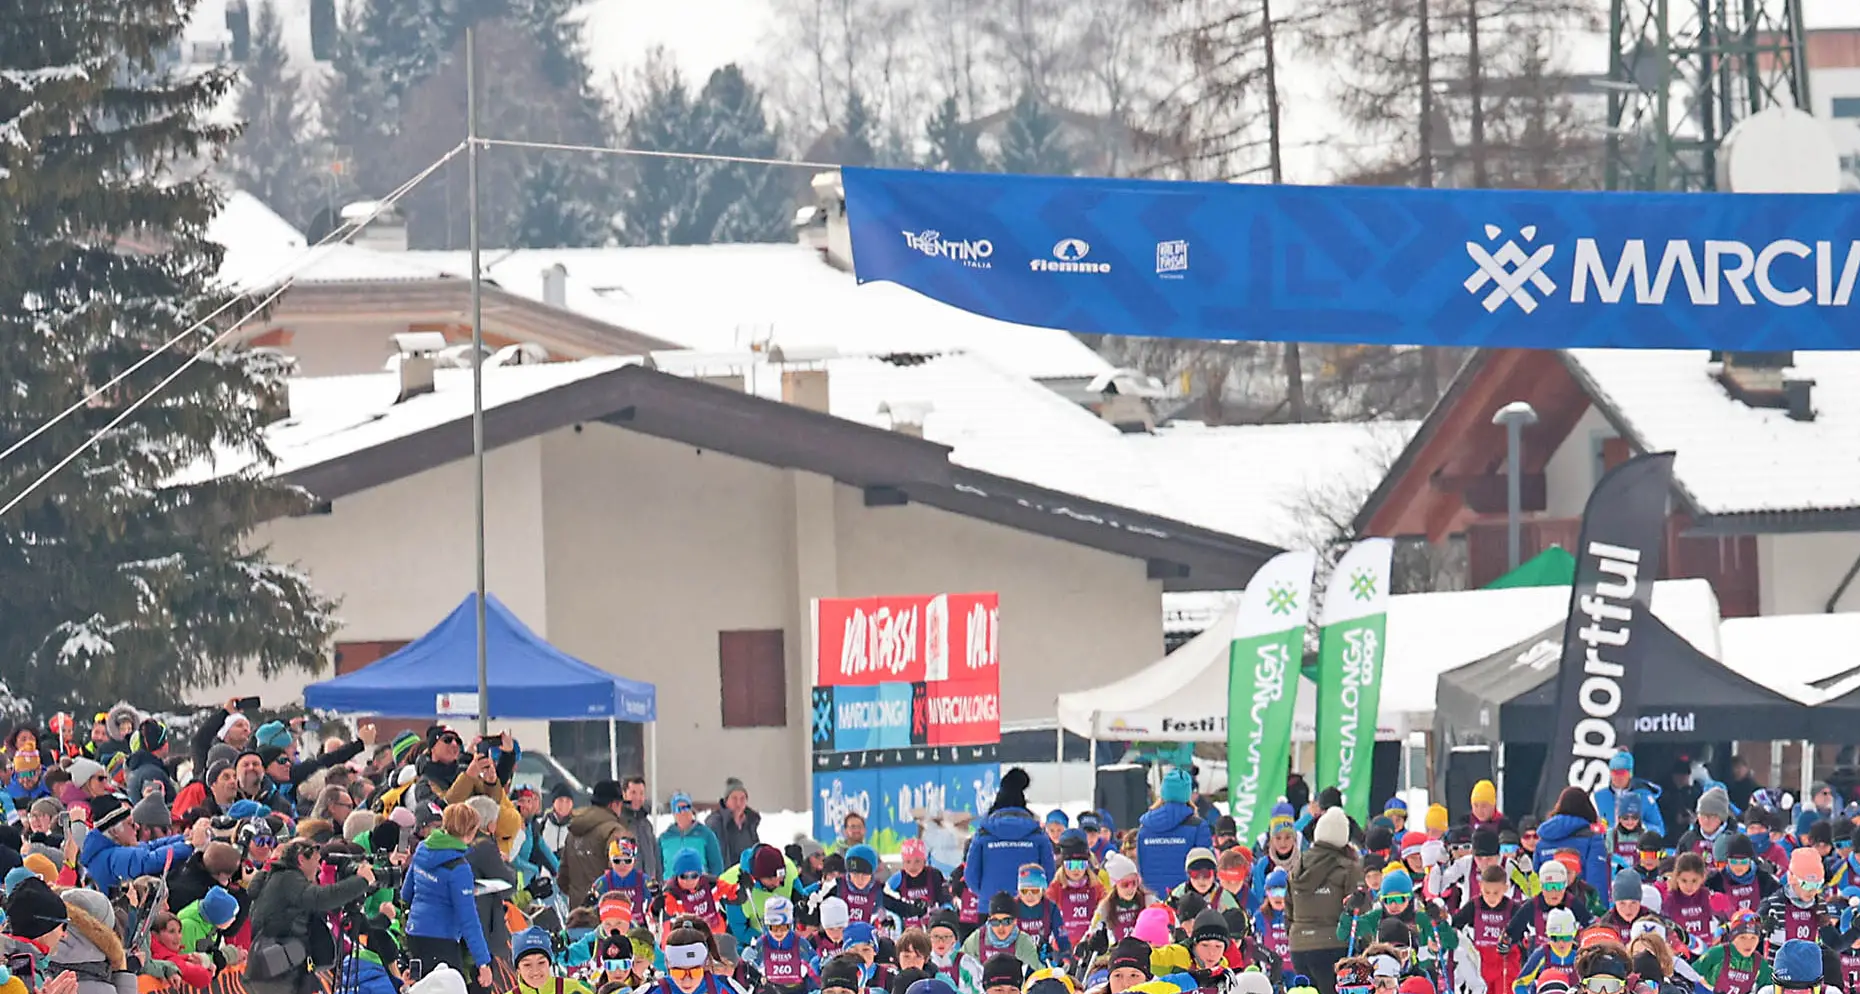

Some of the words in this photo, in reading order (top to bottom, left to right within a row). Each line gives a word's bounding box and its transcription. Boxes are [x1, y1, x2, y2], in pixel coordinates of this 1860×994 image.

[902, 230, 993, 262] TRENTINO
[963, 260, 992, 270] ITALIA
[1030, 258, 1111, 274] fiemme
[1362, 629, 1380, 685] coop
[1338, 628, 1363, 800] ARCIALONGA
[1162, 718, 1214, 733] Festi
[773, 964, 792, 975] 260
